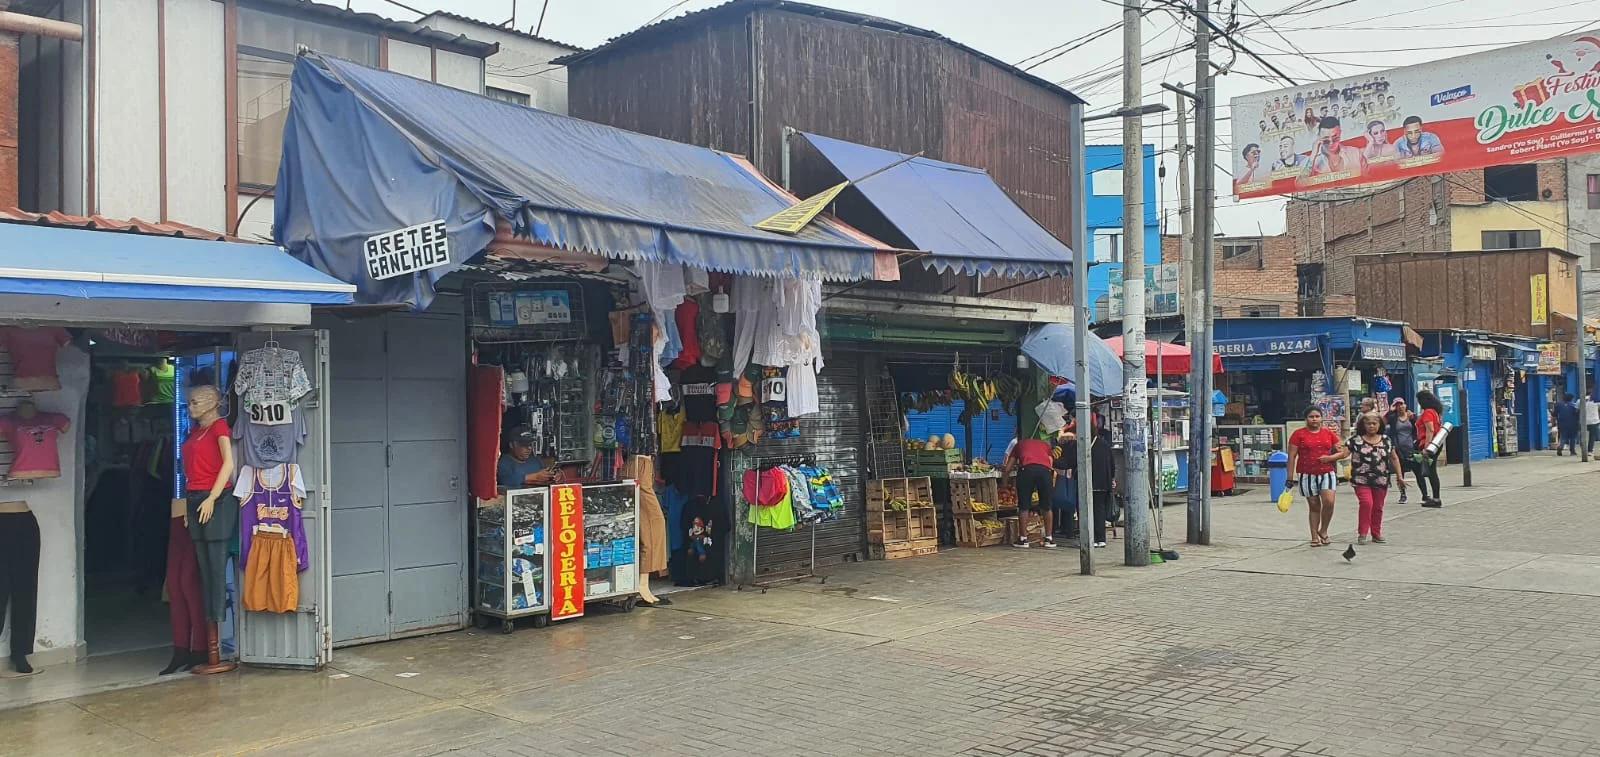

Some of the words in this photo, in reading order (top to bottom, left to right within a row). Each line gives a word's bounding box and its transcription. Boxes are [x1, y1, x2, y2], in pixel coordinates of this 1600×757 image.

[1434, 90, 1467, 103] Velasco
[1478, 103, 1556, 141] Dulce
[1487, 144, 1512, 153] Sandro
[1550, 130, 1587, 141] Guillermo
[1511, 146, 1535, 155] Robert
[1536, 142, 1556, 151] Plant
[366, 222, 447, 258] ARETES
[368, 241, 447, 279] GANCHOS
[1270, 340, 1312, 351] BAZAR
[251, 403, 284, 422] S/10
[558, 487, 578, 616] RELOJERIA
